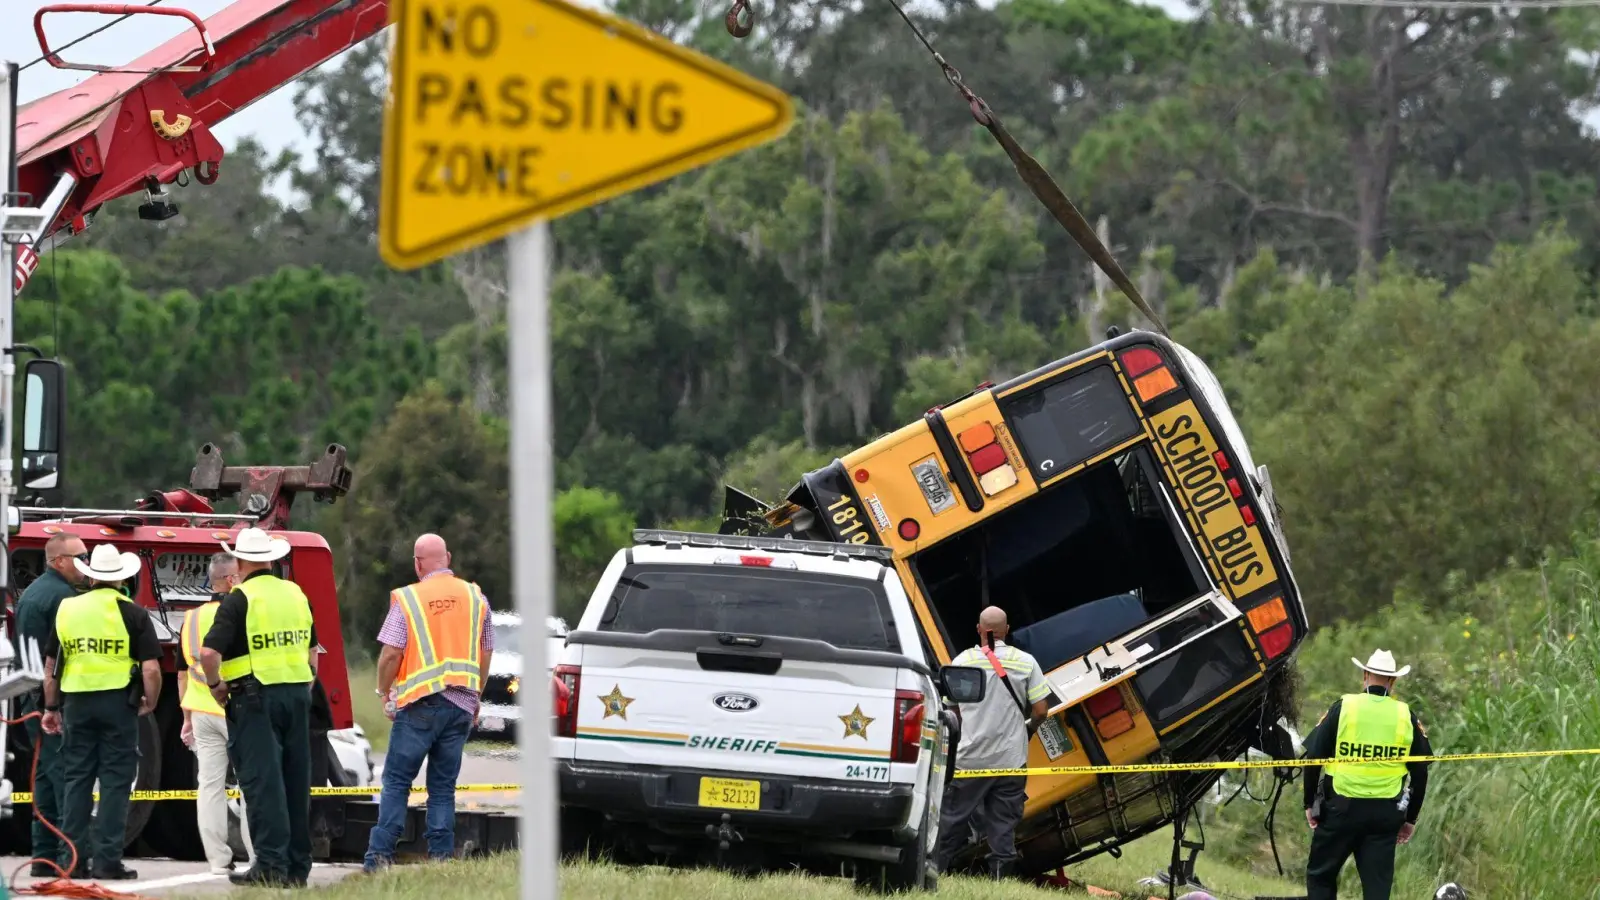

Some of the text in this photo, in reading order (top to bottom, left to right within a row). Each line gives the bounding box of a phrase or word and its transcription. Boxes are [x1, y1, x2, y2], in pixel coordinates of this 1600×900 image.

[418, 5, 499, 58] NO
[414, 71, 685, 134] PASSING
[412, 139, 542, 199] ZONE
[1041, 459, 1054, 471] C
[921, 468, 948, 504] TG7346
[1157, 414, 1264, 586] SCHOOL BUS
[63, 637, 124, 655] SHERIFF
[252, 630, 309, 650] SHERIFF
[721, 696, 751, 709] Ford
[687, 735, 777, 754] SHERIFF
[1339, 741, 1407, 758] SHERIFF
[846, 765, 888, 780] 24-177
[129, 790, 172, 799] HERIFFS
[722, 788, 756, 804] 52133
